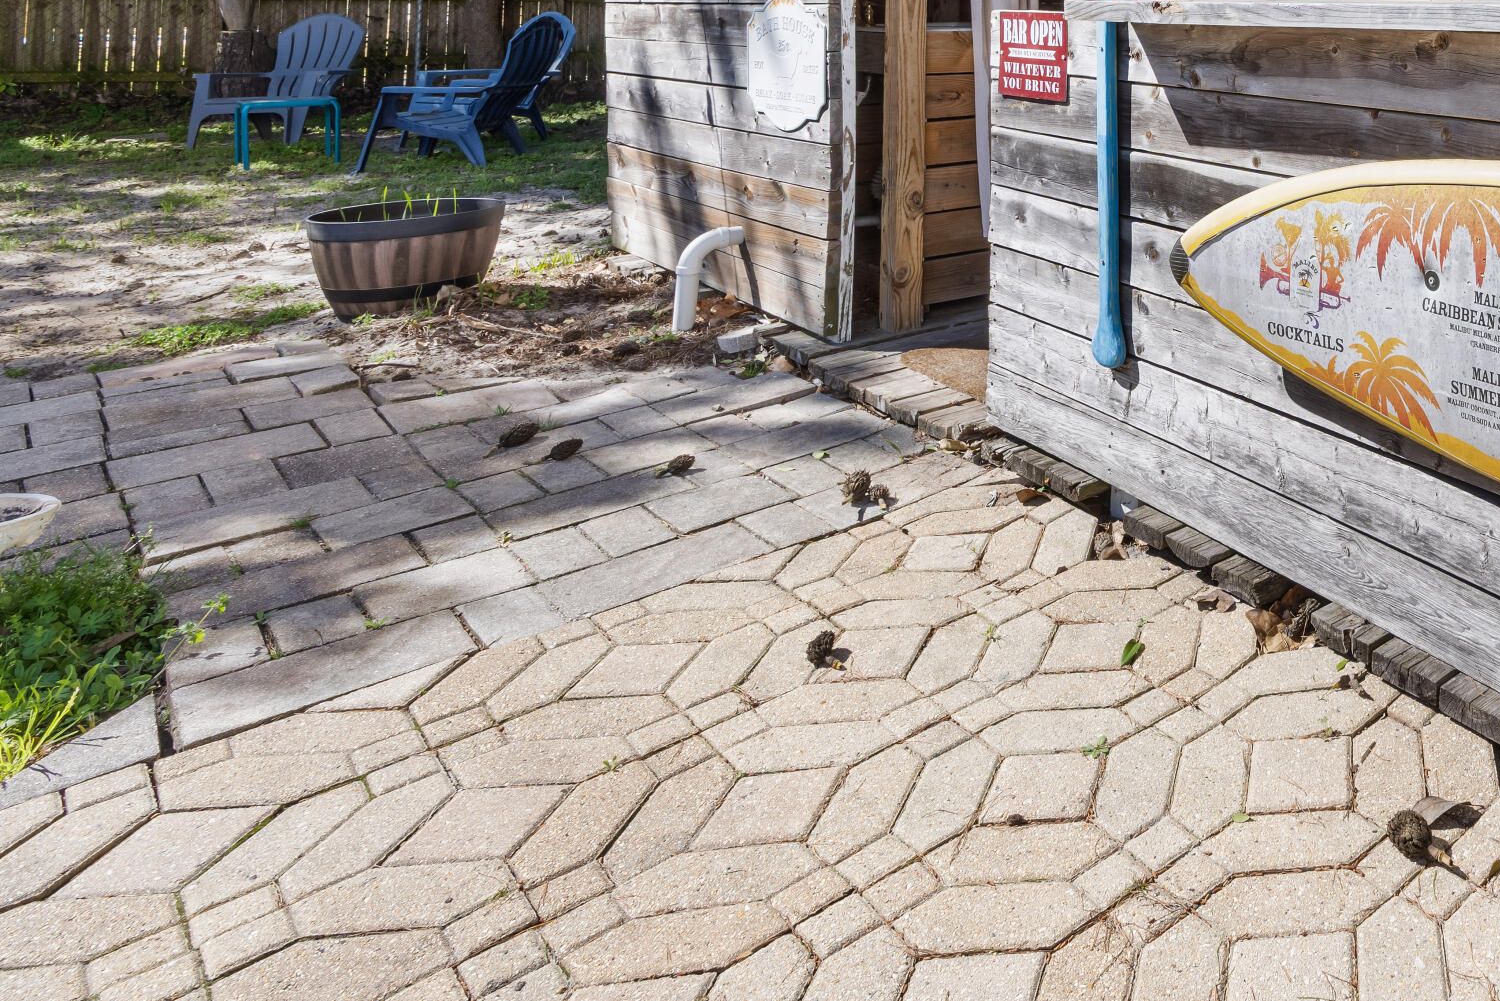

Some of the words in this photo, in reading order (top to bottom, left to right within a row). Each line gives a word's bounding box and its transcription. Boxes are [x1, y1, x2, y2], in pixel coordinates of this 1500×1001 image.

[1003, 19, 1027, 44] BAR
[1030, 20, 1063, 47] OPEN
[1004, 62, 1061, 78] WHATEVER
[1003, 76, 1022, 89] YOU
[1025, 79, 1059, 94] BRING
[1294, 259, 1319, 274] MALIBU
[1422, 297, 1497, 329] CARIBBEAN
[1268, 322, 1344, 352] COCKTAILS
[1450, 323, 1472, 335] MALIBU
[1473, 329, 1493, 340] MELON,
[1448, 397, 1469, 408] MALIBU
[1461, 412, 1476, 422] CLUB
[1476, 418, 1492, 428] SODA
